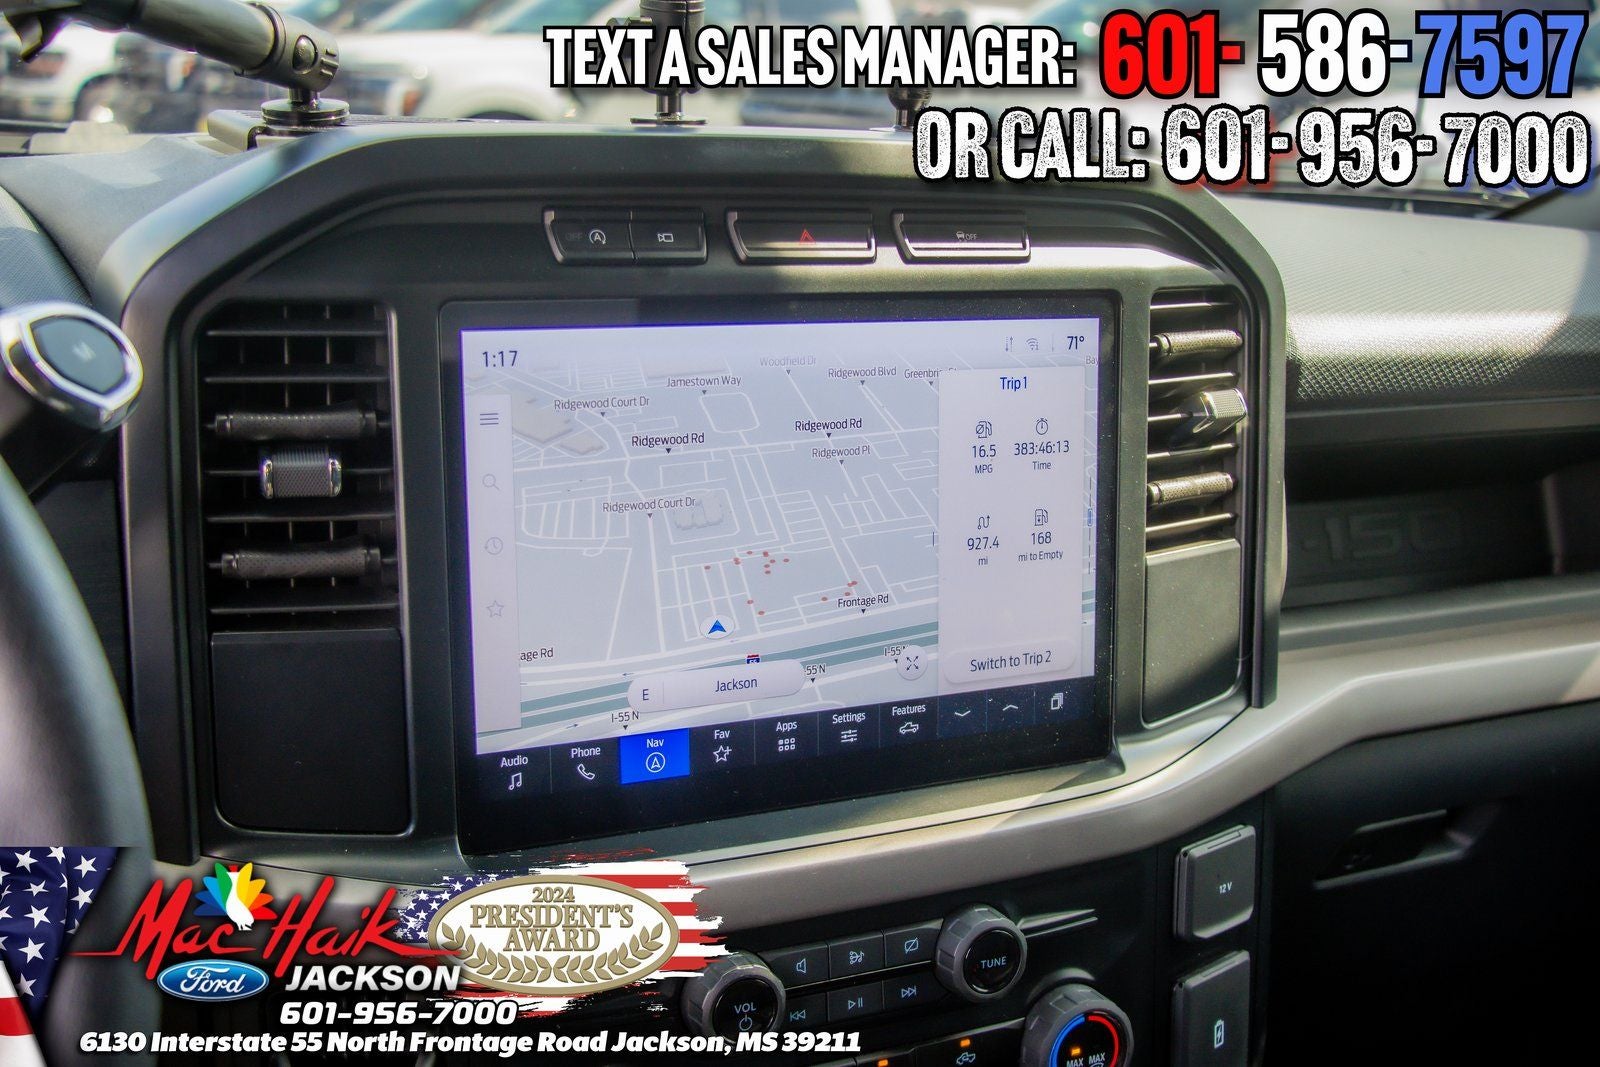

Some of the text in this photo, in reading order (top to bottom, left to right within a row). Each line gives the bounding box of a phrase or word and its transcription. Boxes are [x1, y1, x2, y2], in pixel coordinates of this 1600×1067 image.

[965, 233, 977, 241] OFF
[1067, 335, 1085, 350] 71°
[482, 350, 518, 367] 1:17
[760, 355, 817, 367] Woodfield Dr
[828, 366, 897, 381] Ridgewood Blvd
[666, 374, 742, 388] Jamestown Way
[1000, 377, 1028, 392] Trip 1
[554, 395, 650, 411] Ridgewood Court Dr
[795, 417, 862, 433] Ridgewood Rd
[631, 432, 705, 448] Ridgewood Rd
[812, 445, 871, 460] Ridgewood Pl
[972, 445, 997, 458] 16.5
[1013, 440, 1070, 456] 383:46:13
[974, 464, 993, 474] MPG
[1032, 460, 1052, 471] Time
[602, 497, 696, 514] Ridgewood Court Dr
[967, 536, 1000, 551] 927.4
[1031, 532, 1052, 545] 168
[978, 556, 988, 566] mi
[1018, 549, 1064, 563] mi to Empty
[838, 593, 889, 611] Frontage Rd
[540, 648, 554, 658] Rd
[970, 651, 1052, 672] Switch to Trip 2
[819, 664, 826, 674] N
[715, 676, 758, 693] Jackson
[642, 689, 650, 701] E
[892, 702, 926, 716] Features
[611, 710, 640, 723] I-55 N
[832, 709, 866, 725] Settings
[775, 720, 797, 733] Apps
[714, 729, 730, 740] Fav
[646, 737, 665, 749] Nav
[571, 746, 601, 759] Phone
[501, 754, 529, 767] Audio
[981, 955, 1007, 969] TUNE
[734, 1002, 757, 1014] VOL
[1088, 1052, 1106, 1065] MAX
